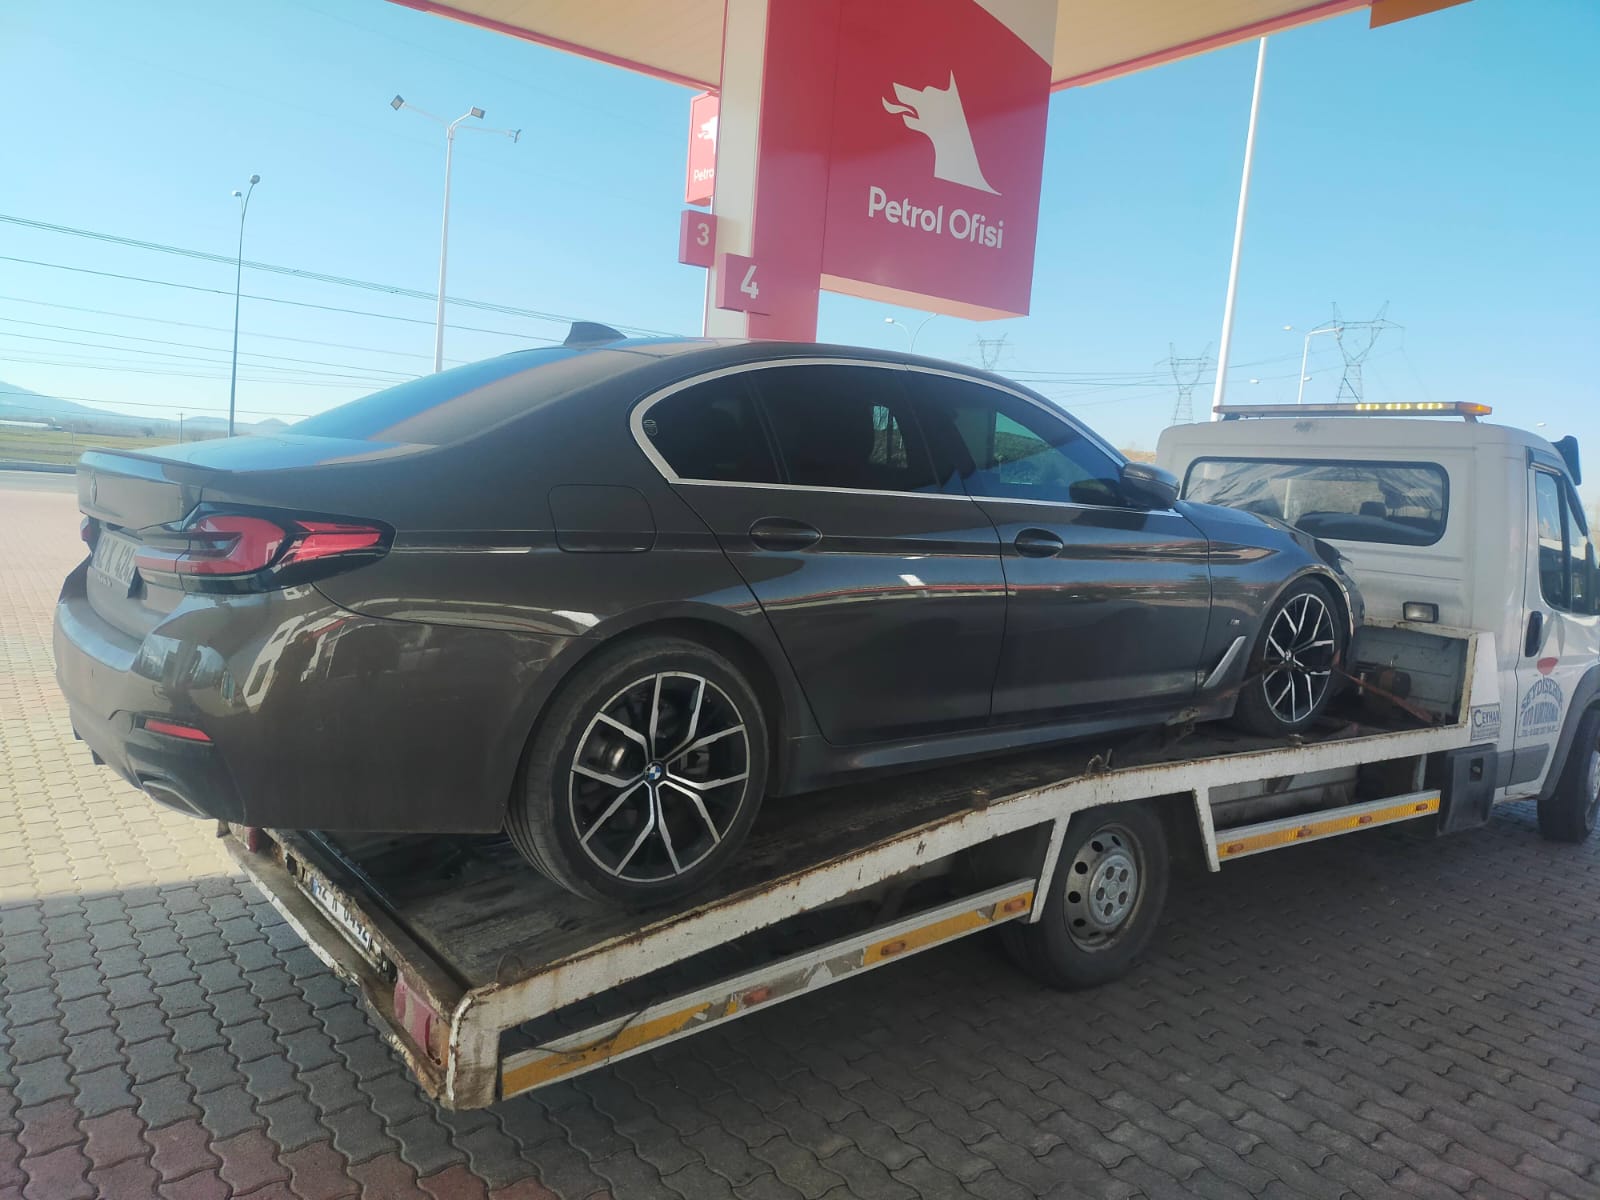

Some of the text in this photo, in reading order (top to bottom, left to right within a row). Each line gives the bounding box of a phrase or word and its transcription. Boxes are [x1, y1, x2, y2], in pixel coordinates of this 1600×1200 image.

[868, 185, 1004, 249] Petrol Ofisi
[696, 222, 710, 247] 3
[740, 265, 759, 299] 4
